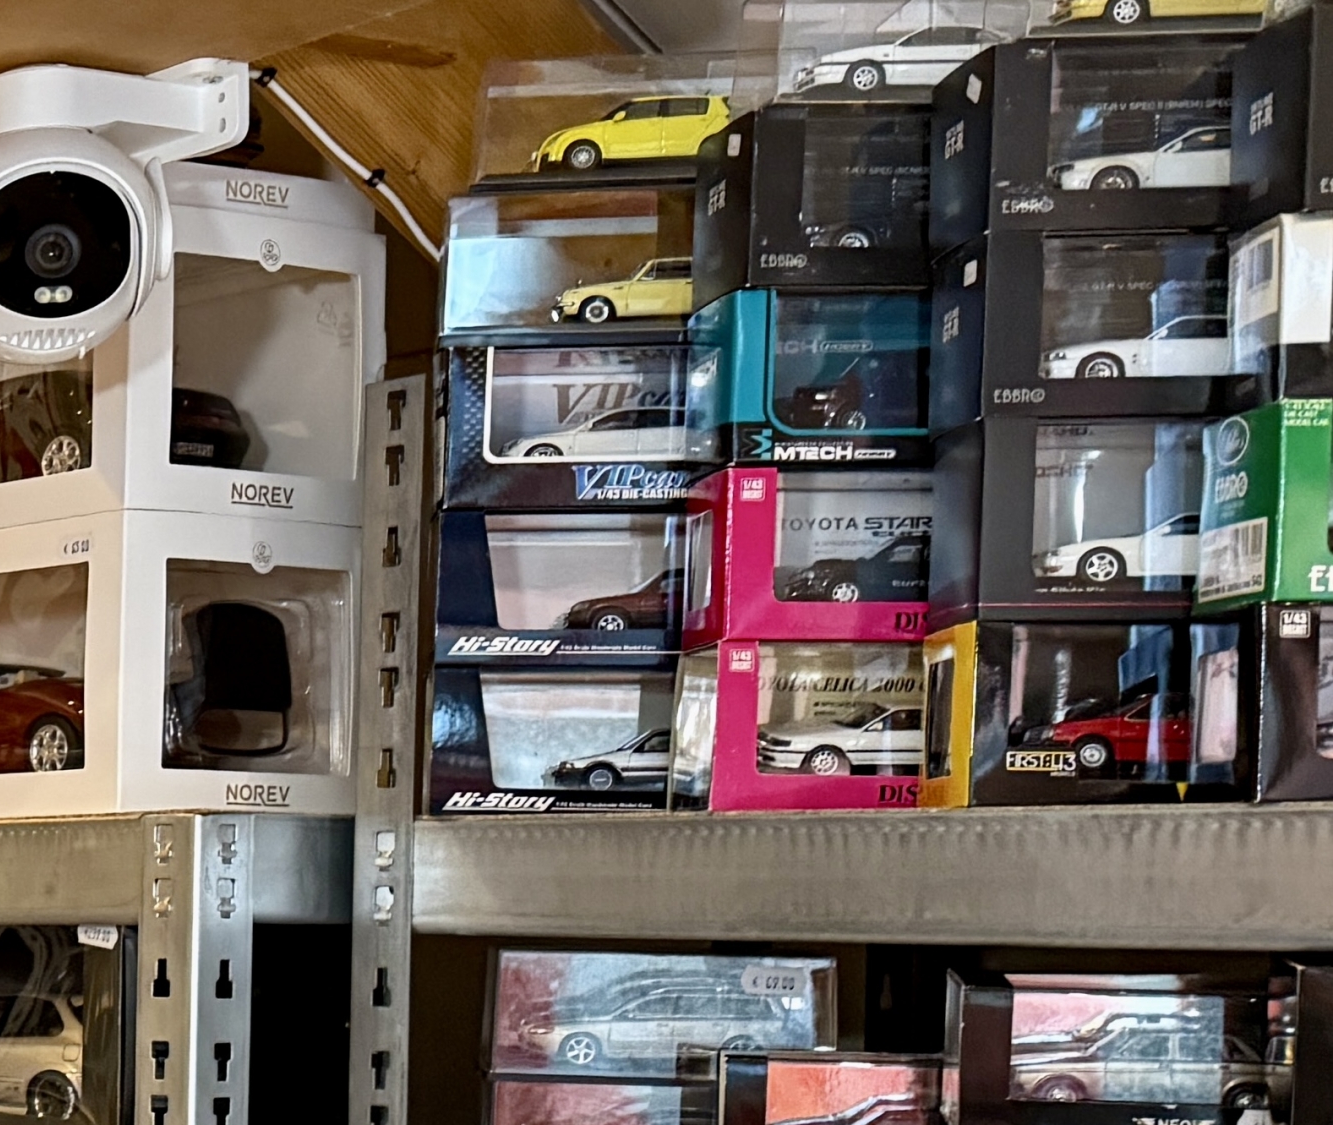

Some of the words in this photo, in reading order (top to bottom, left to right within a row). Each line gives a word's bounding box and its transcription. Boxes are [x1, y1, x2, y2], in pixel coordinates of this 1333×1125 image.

[1249, 104, 1274, 136] GT-R
[226, 180, 290, 208] NOREV
[994, 388, 1046, 403] EBBRO
[774, 446, 853, 461] MTECH
[597, 488, 620, 499] 1/43
[622, 487, 688, 499] DIE-CASTING
[743, 479, 763, 490] 1/43
[230, 482, 295, 509] NOREV
[1283, 612, 1307, 624] 1/43
[448, 636, 560, 656] Hi-Story
[732, 650, 752, 662] 1/43
[226, 784, 291, 807] NOREV
[442, 792, 556, 811] Hi-Story
